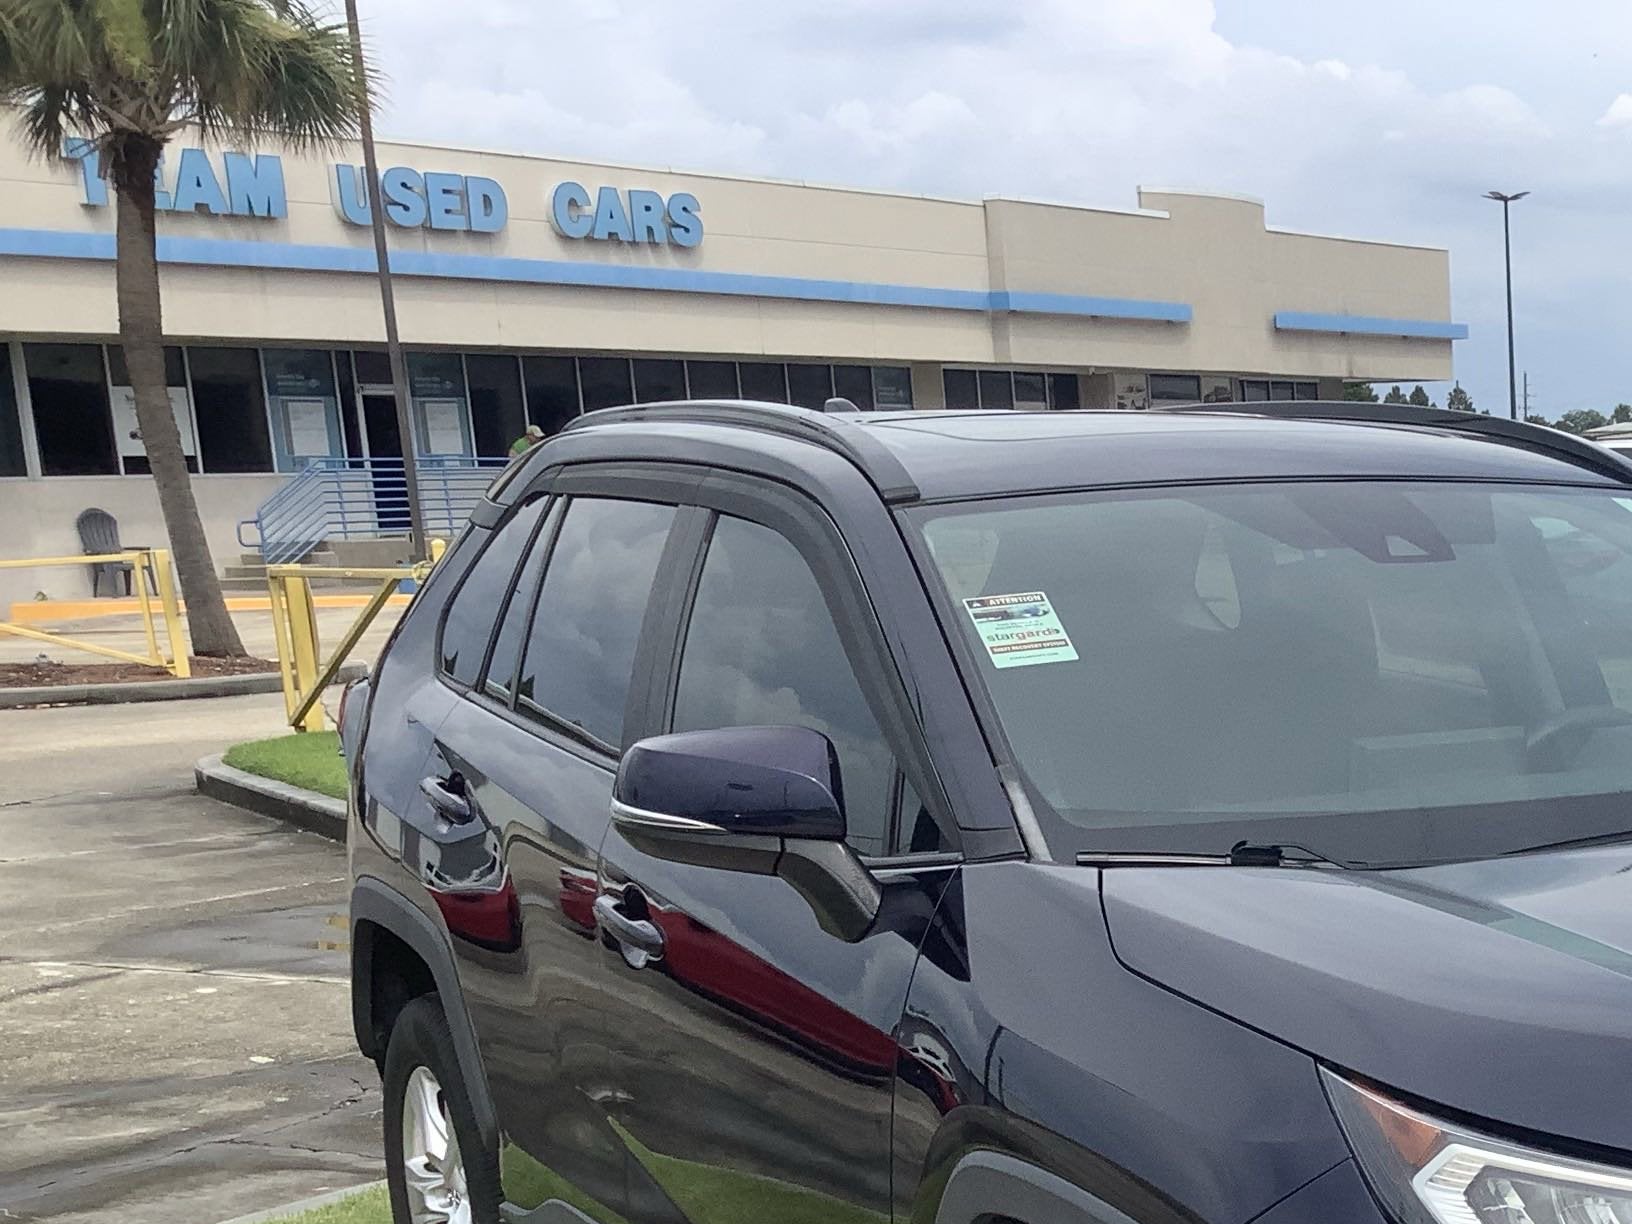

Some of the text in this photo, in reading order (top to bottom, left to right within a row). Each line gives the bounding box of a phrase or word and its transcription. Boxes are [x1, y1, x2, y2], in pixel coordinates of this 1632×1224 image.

[62, 137, 704, 247] TAM USED CARS
[989, 594, 1042, 606] ATTENTION
